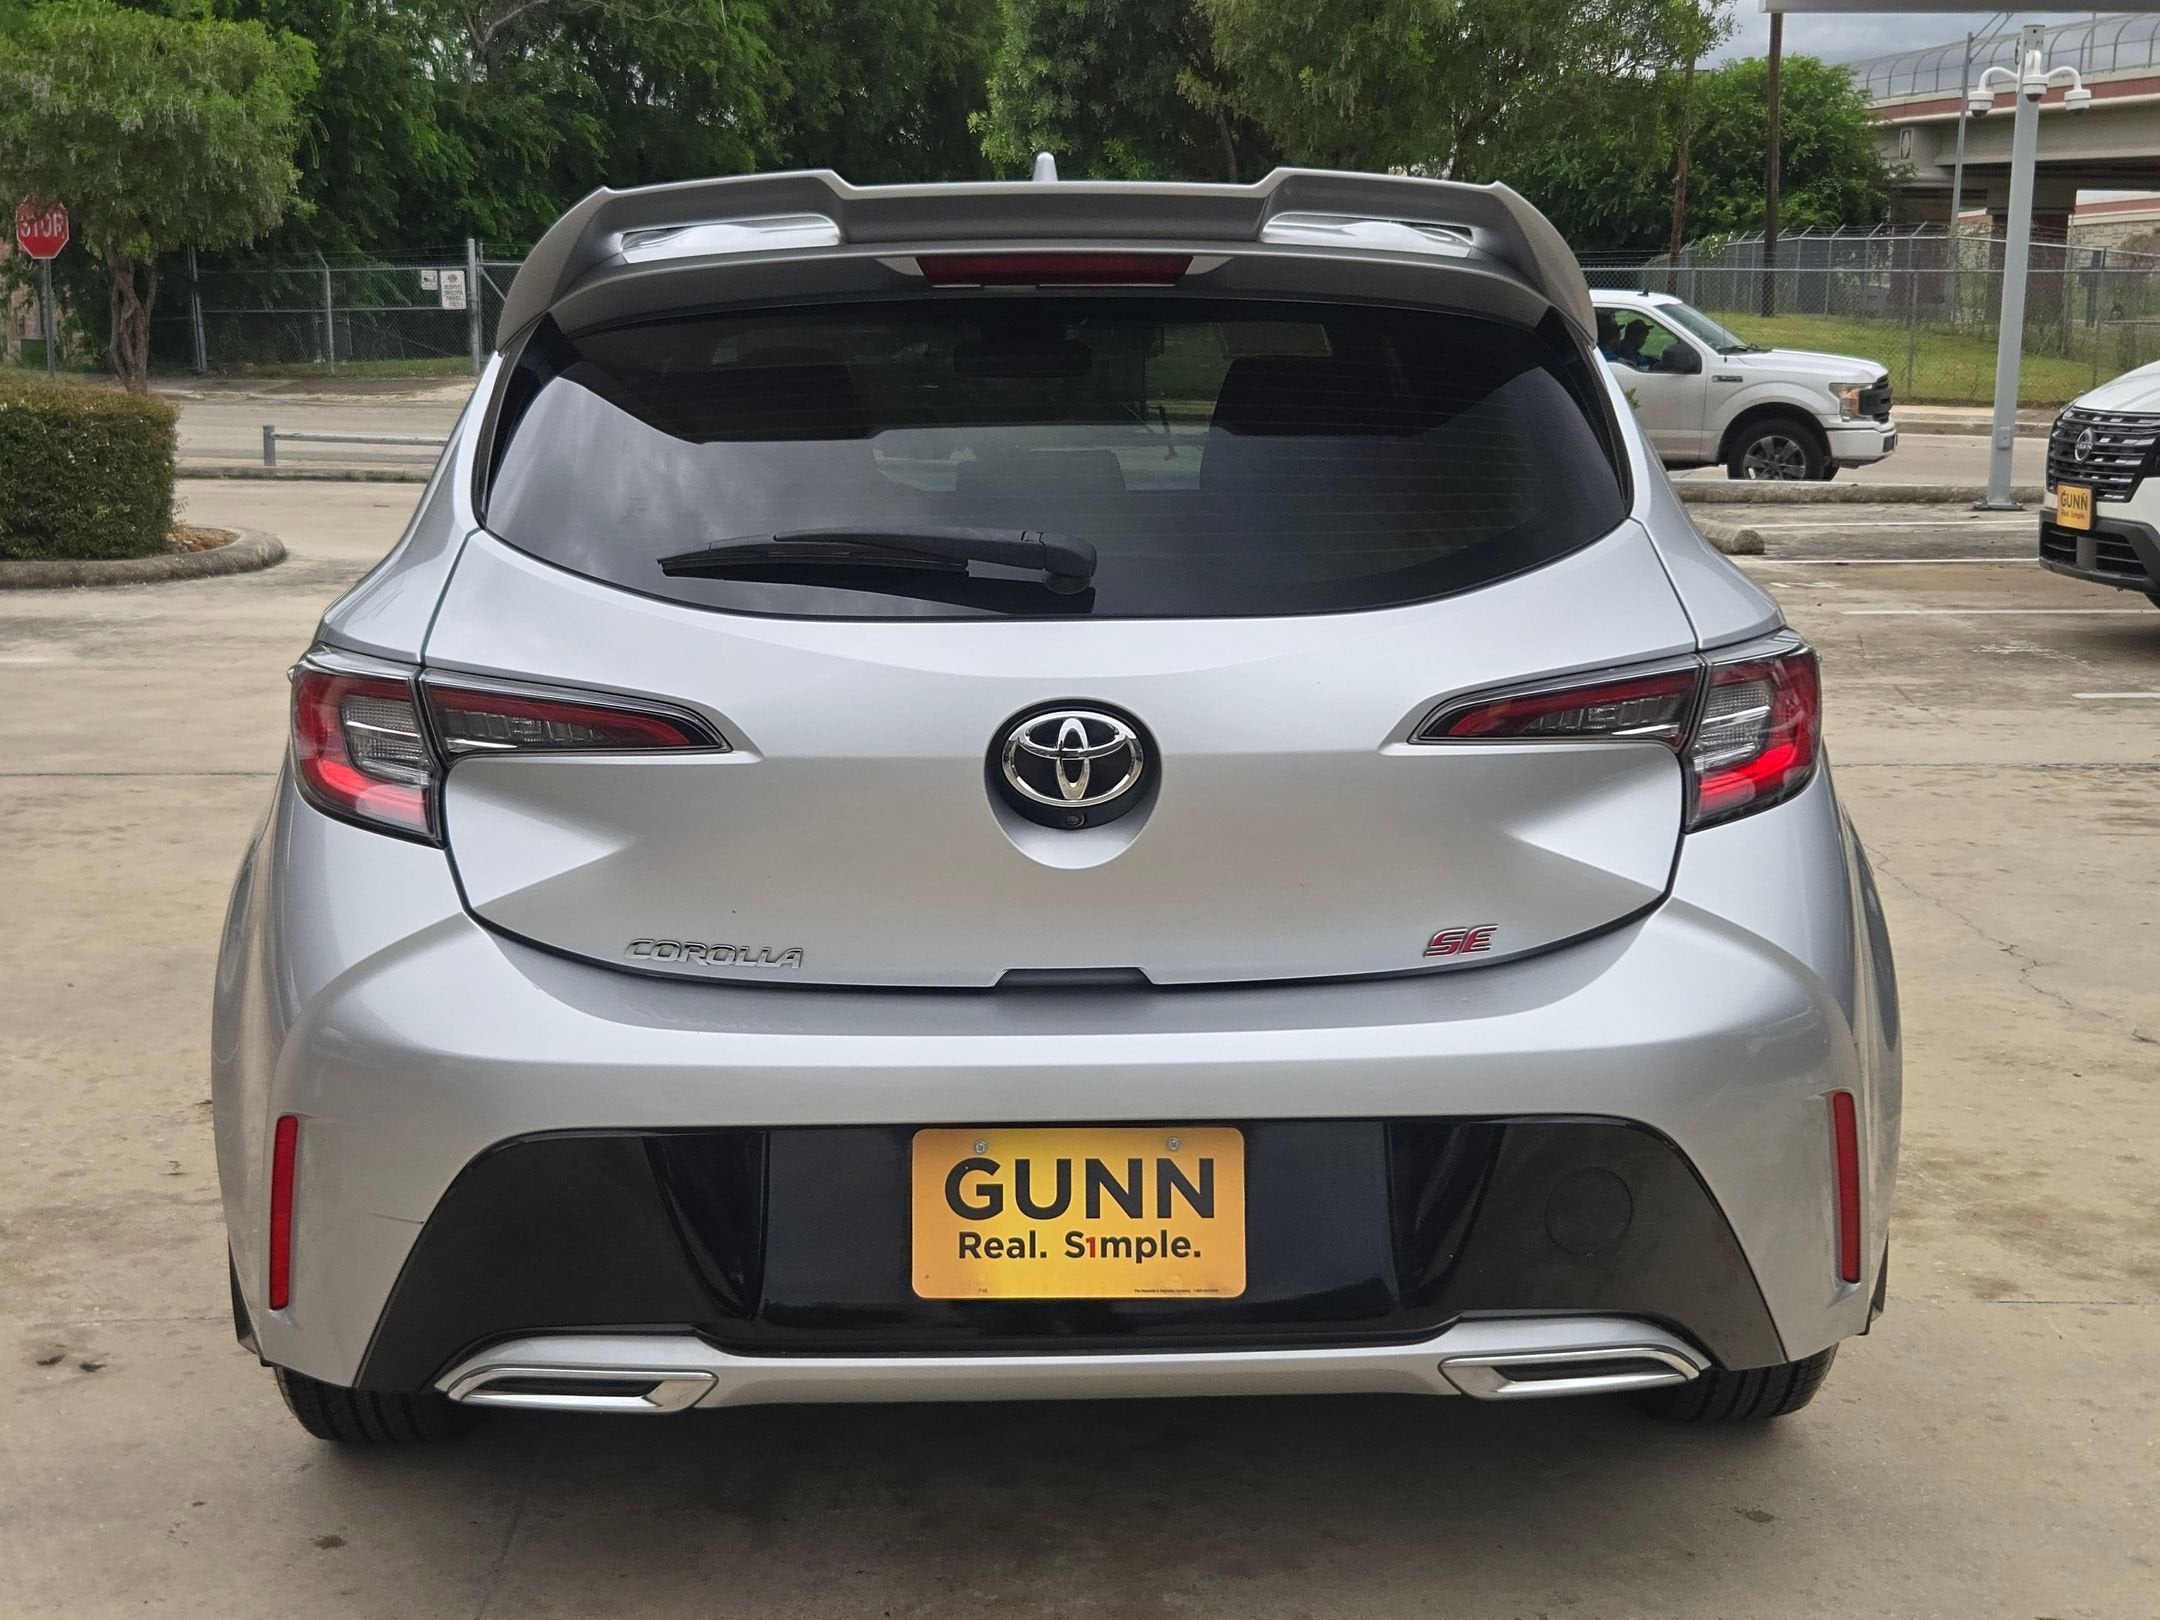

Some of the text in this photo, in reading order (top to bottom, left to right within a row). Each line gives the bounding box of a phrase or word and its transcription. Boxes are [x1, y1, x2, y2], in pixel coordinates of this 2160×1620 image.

[2060, 492, 2088, 511] GUNN
[625, 939, 803, 969] COROLLA
[1423, 924, 1498, 957] SE
[945, 1157, 1215, 1221] GUNN
[958, 1230, 1047, 1259] Real.
